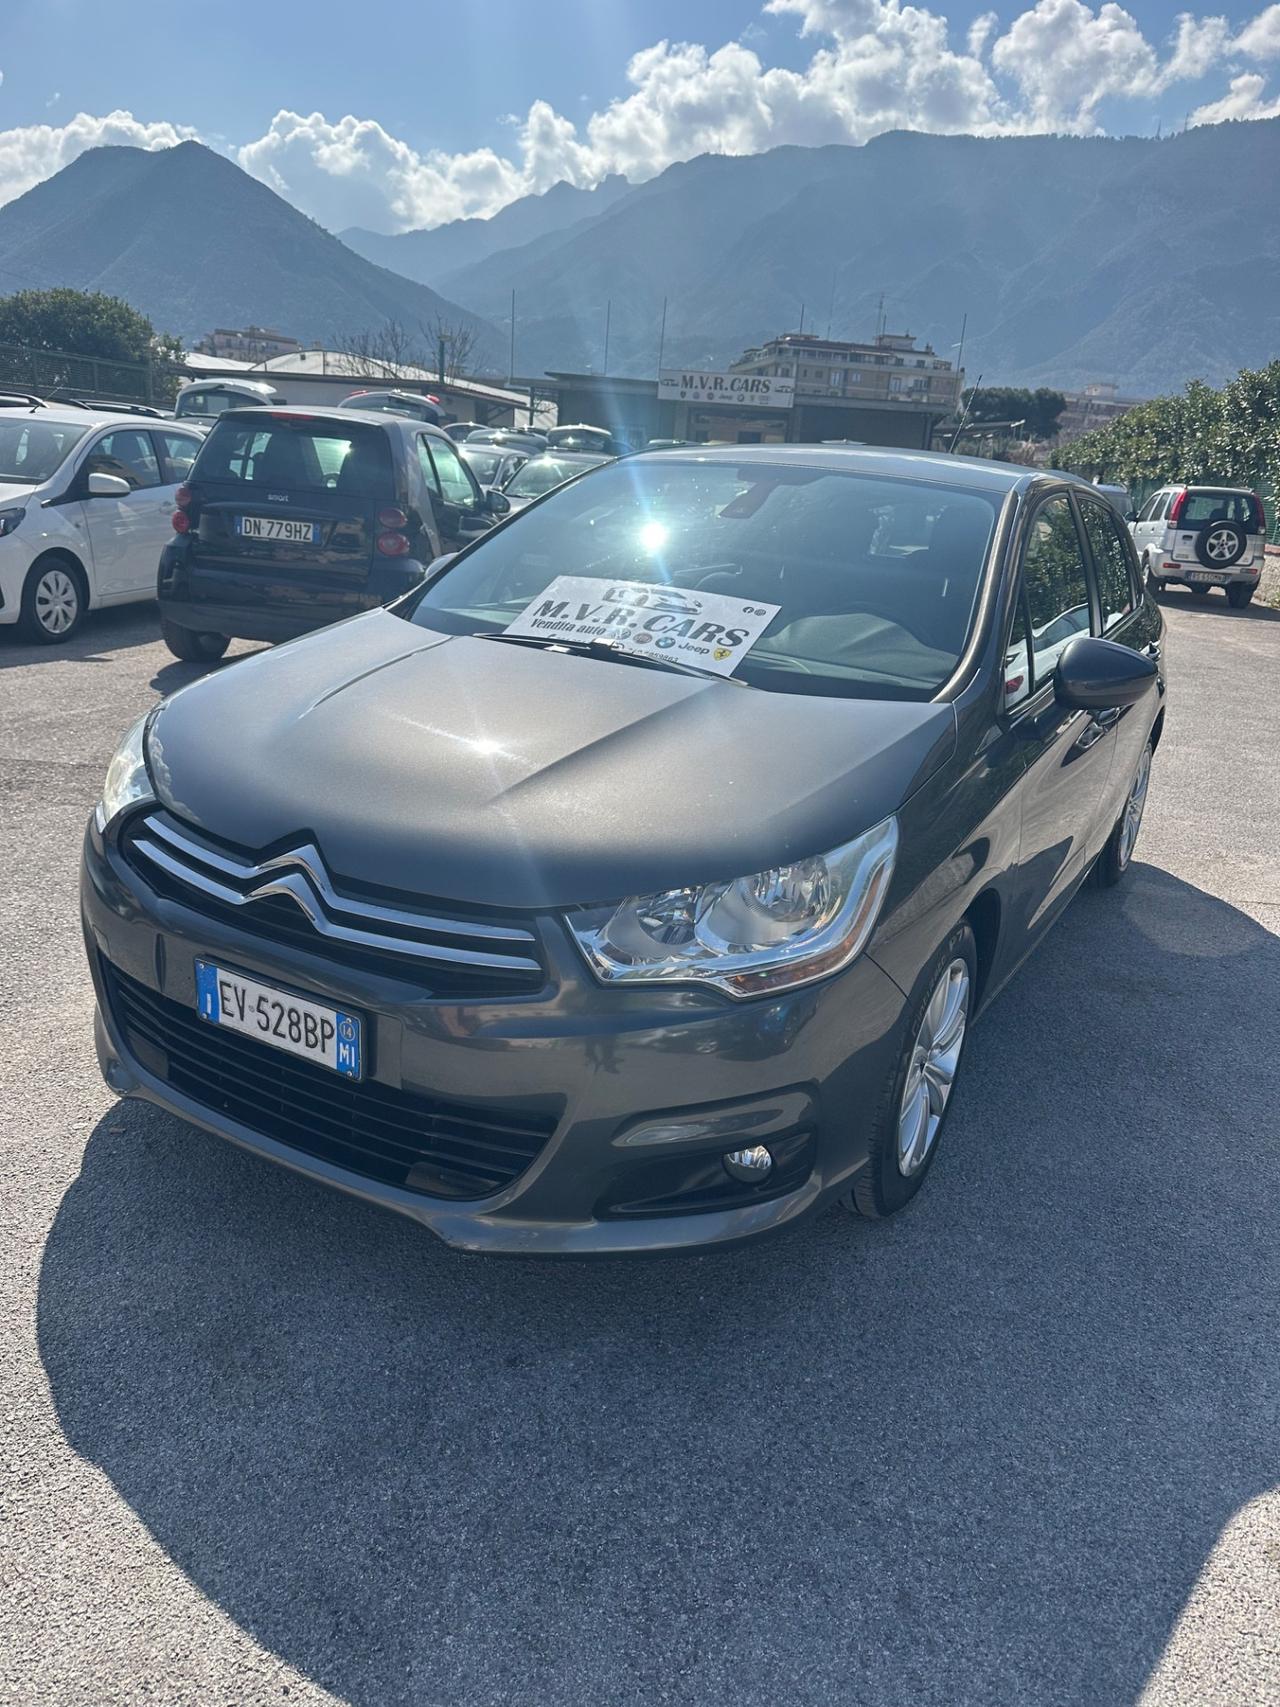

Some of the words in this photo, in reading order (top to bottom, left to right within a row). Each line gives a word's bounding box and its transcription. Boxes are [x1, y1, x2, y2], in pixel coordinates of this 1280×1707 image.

[530, 618, 576, 632] Vendita
[576, 624, 607, 636] auto
[678, 642, 710, 655] Jeep
[339, 1042, 355, 1068] MI
